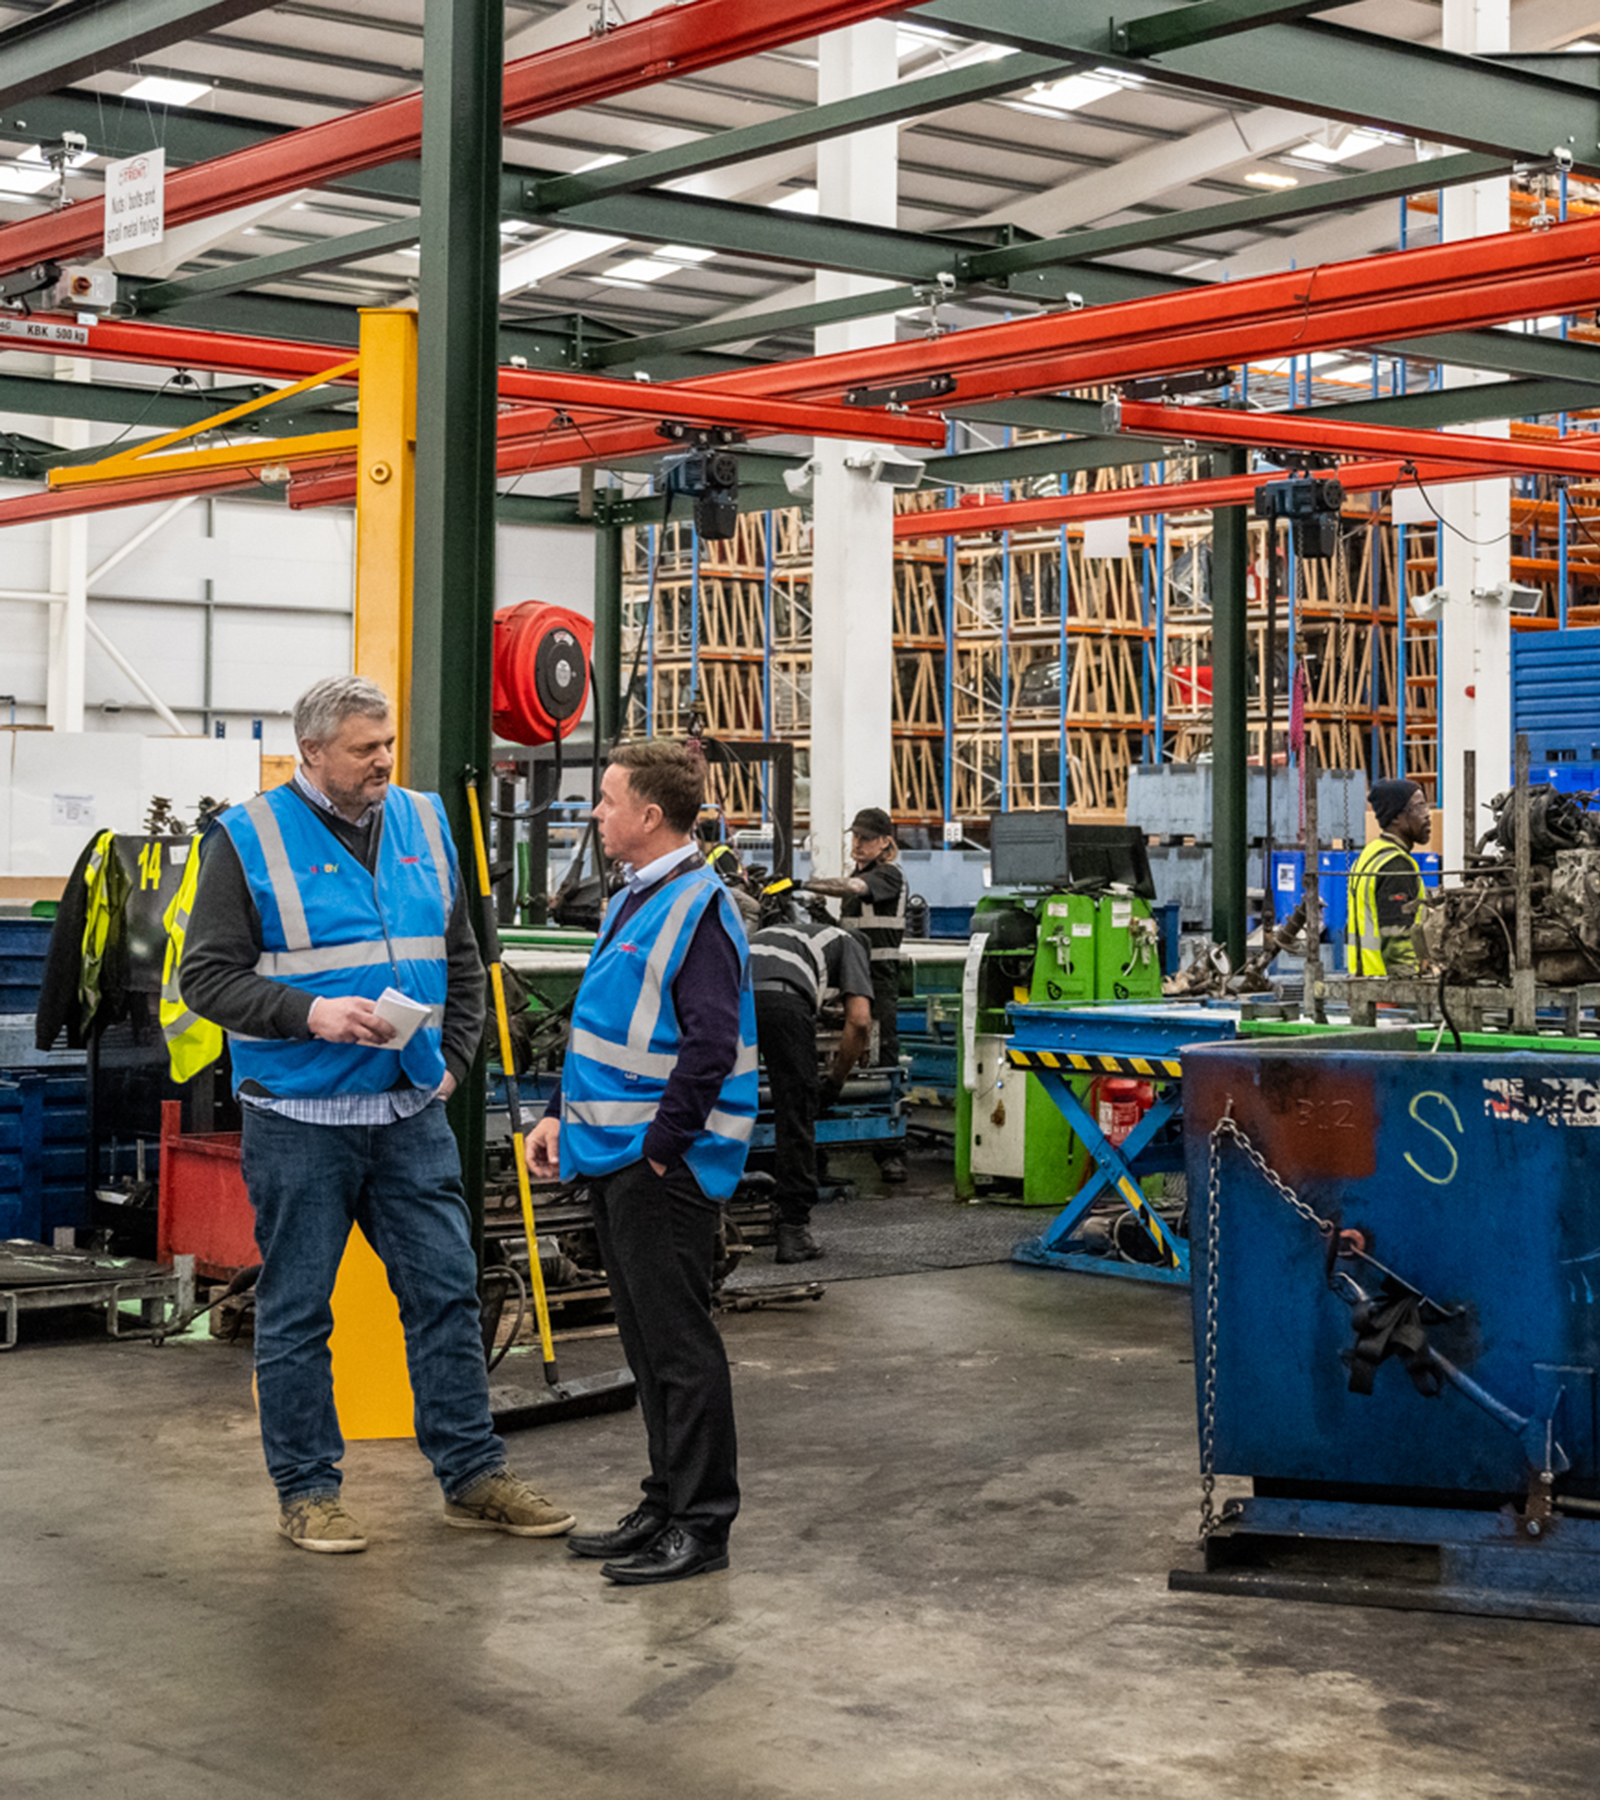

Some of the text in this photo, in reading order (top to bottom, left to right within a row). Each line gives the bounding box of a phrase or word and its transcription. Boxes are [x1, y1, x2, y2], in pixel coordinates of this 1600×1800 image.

[27, 324, 49, 337] KBK
[55, 328, 73, 340] 500
[138, 842, 162, 890] 14
[1403, 1090, 1464, 1185] S
